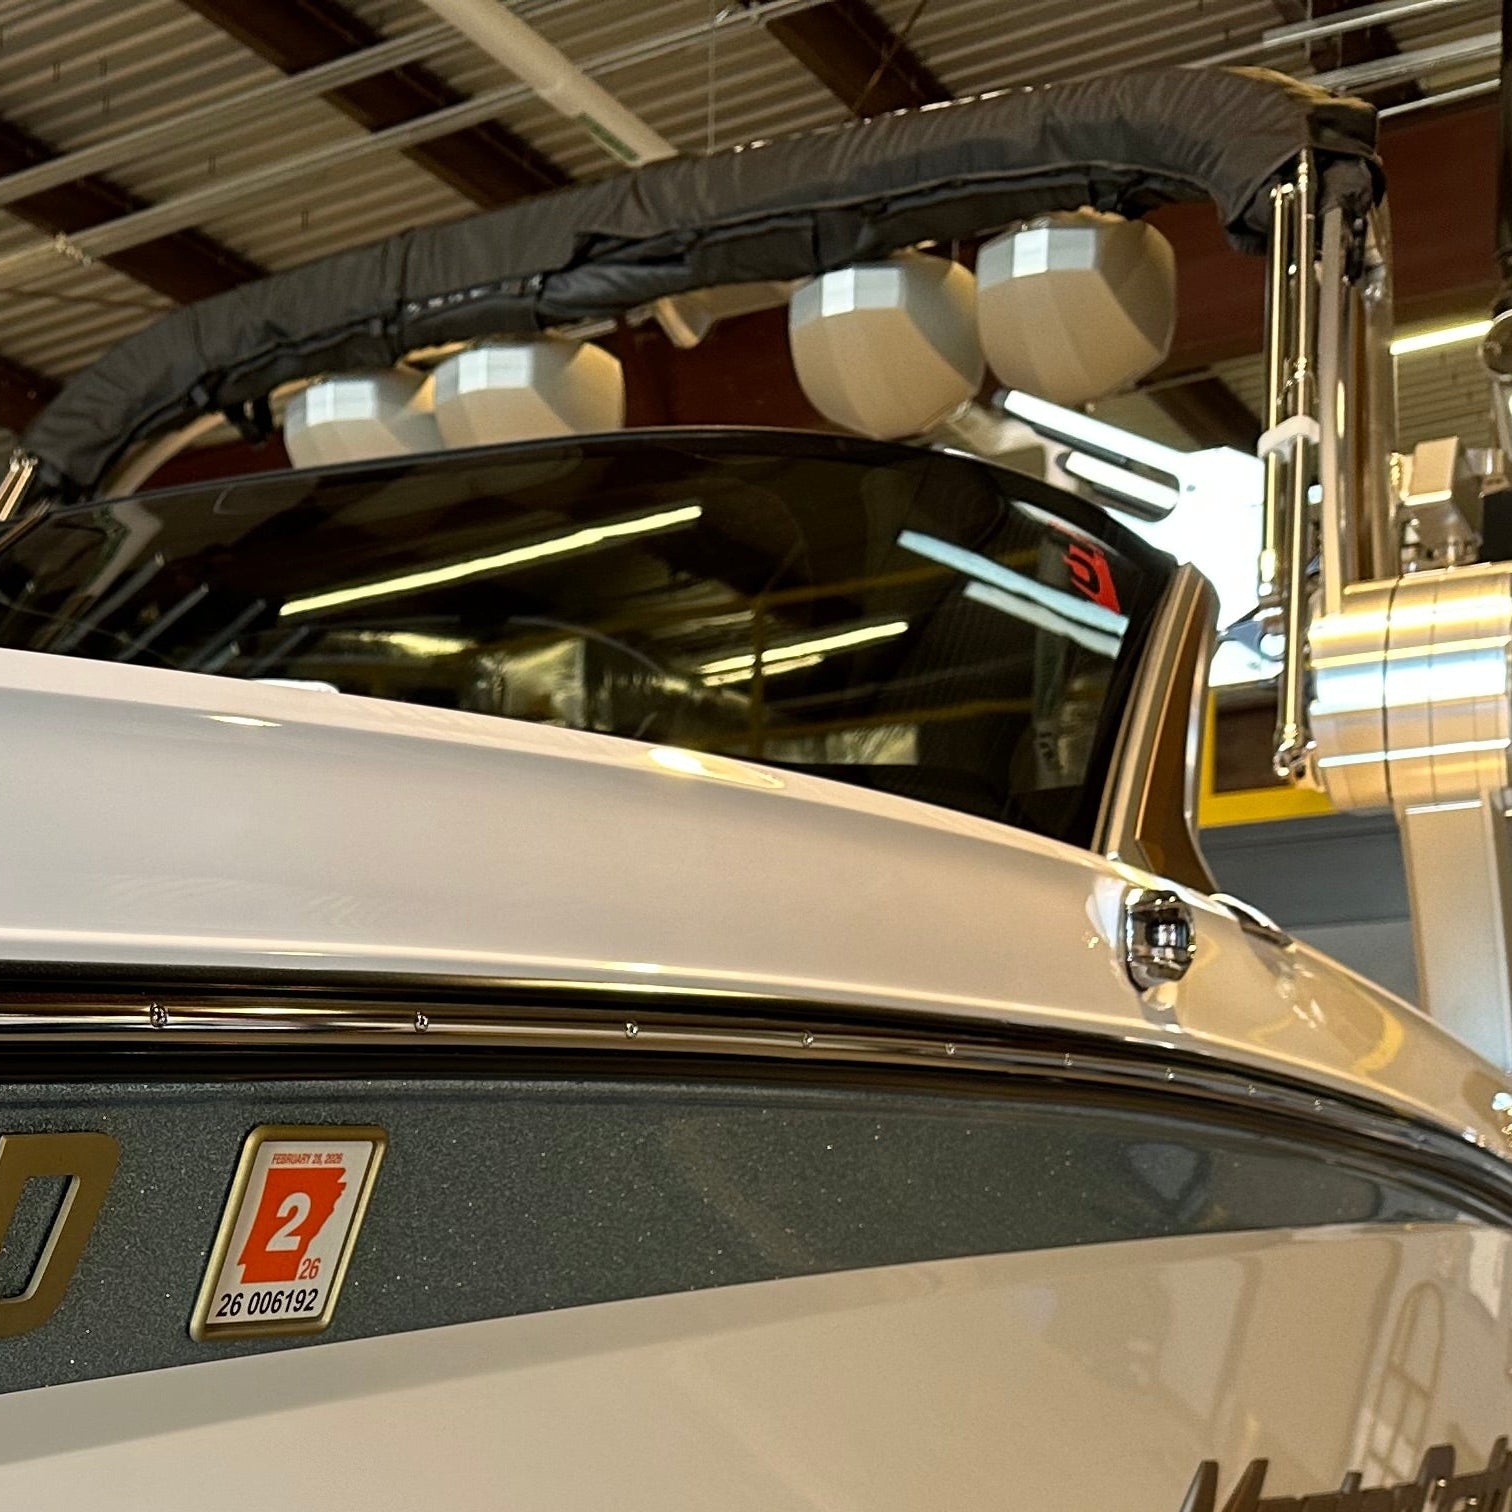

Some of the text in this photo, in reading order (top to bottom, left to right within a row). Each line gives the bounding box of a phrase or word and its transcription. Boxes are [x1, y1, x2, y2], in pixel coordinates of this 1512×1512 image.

[271, 1154, 312, 1165] FEBRUARY
[265, 1192, 312, 1252] 2
[298, 1258, 321, 1280] 26
[216, 1288, 319, 1318] 26 006192
